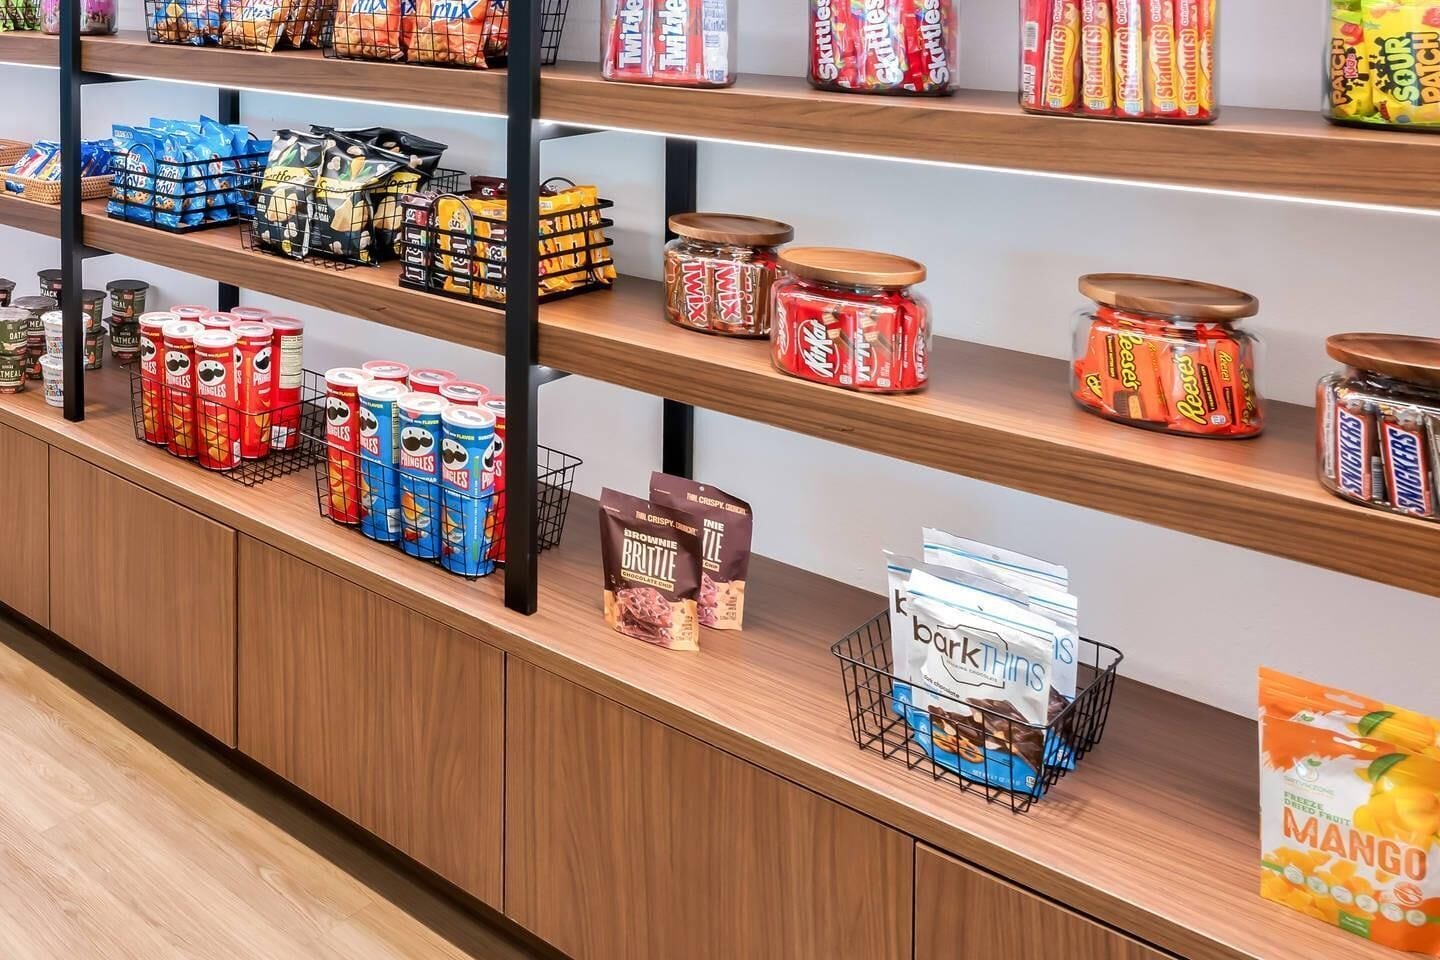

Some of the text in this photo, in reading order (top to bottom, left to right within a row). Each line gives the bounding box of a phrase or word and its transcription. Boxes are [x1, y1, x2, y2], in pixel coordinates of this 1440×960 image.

[1048, 25, 1067, 97] Starburst
[1084, 25, 1104, 98] Starburst
[1154, 25, 1174, 99] Starburst
[1182, 29, 1198, 103] Starburst
[1331, 38, 1350, 106] PATCH
[1384, 38, 1421, 103] SOUR
[1411, 31, 1440, 105] PATCH
[166, 374, 191, 389] PRINGLES
[199, 383, 228, 399] PRINGLES
[1175, 353, 1209, 426] Reese's
[400, 452, 435, 473] PRINGLES
[1339, 408, 1363, 497] SNICKERS
[1387, 426, 1426, 515] SNICKERS
[647, 514, 676, 528] CRISPY.
[698, 496, 726, 510] CRISPY.
[621, 537, 678, 583] BRITTLE
[623, 527, 678, 550] BROWNIE
[622, 570, 673, 590] CHOCOLATE CHIP
[1283, 791, 1324, 811] FREEZE
[1283, 798, 1352, 827] DRIED FRUIT
[1282, 806, 1428, 882] MANGO
